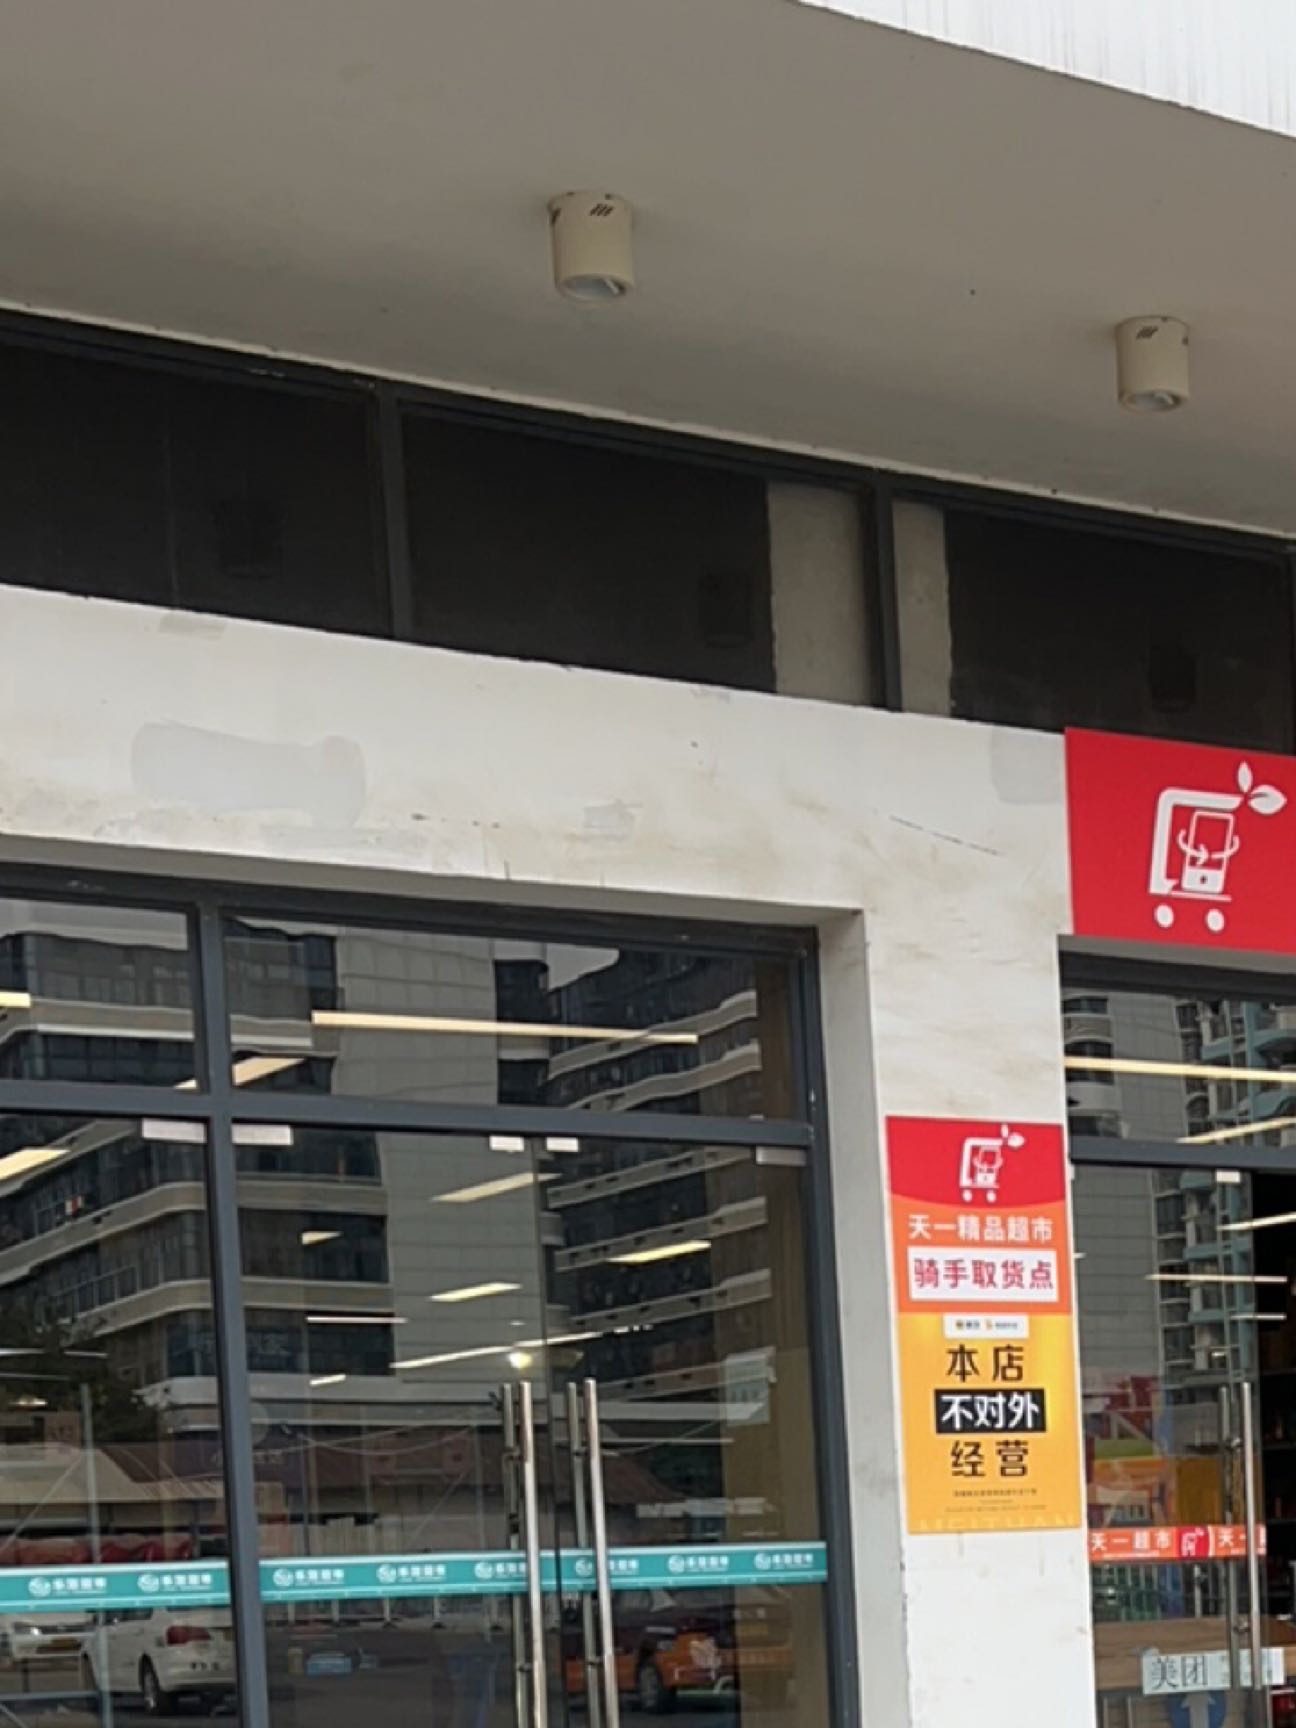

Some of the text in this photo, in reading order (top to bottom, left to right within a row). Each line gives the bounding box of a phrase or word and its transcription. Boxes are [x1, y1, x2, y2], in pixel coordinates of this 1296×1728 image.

[908, 1213, 1053, 1245] 天一精品超市
[913, 1257, 1054, 1291] 骑手取货点
[946, 1344, 1025, 1383] 本店
[940, 1392, 1041, 1430] 不对外
[950, 1440, 1030, 1478] 经营
[1150, 1655, 1208, 1691] 美团
